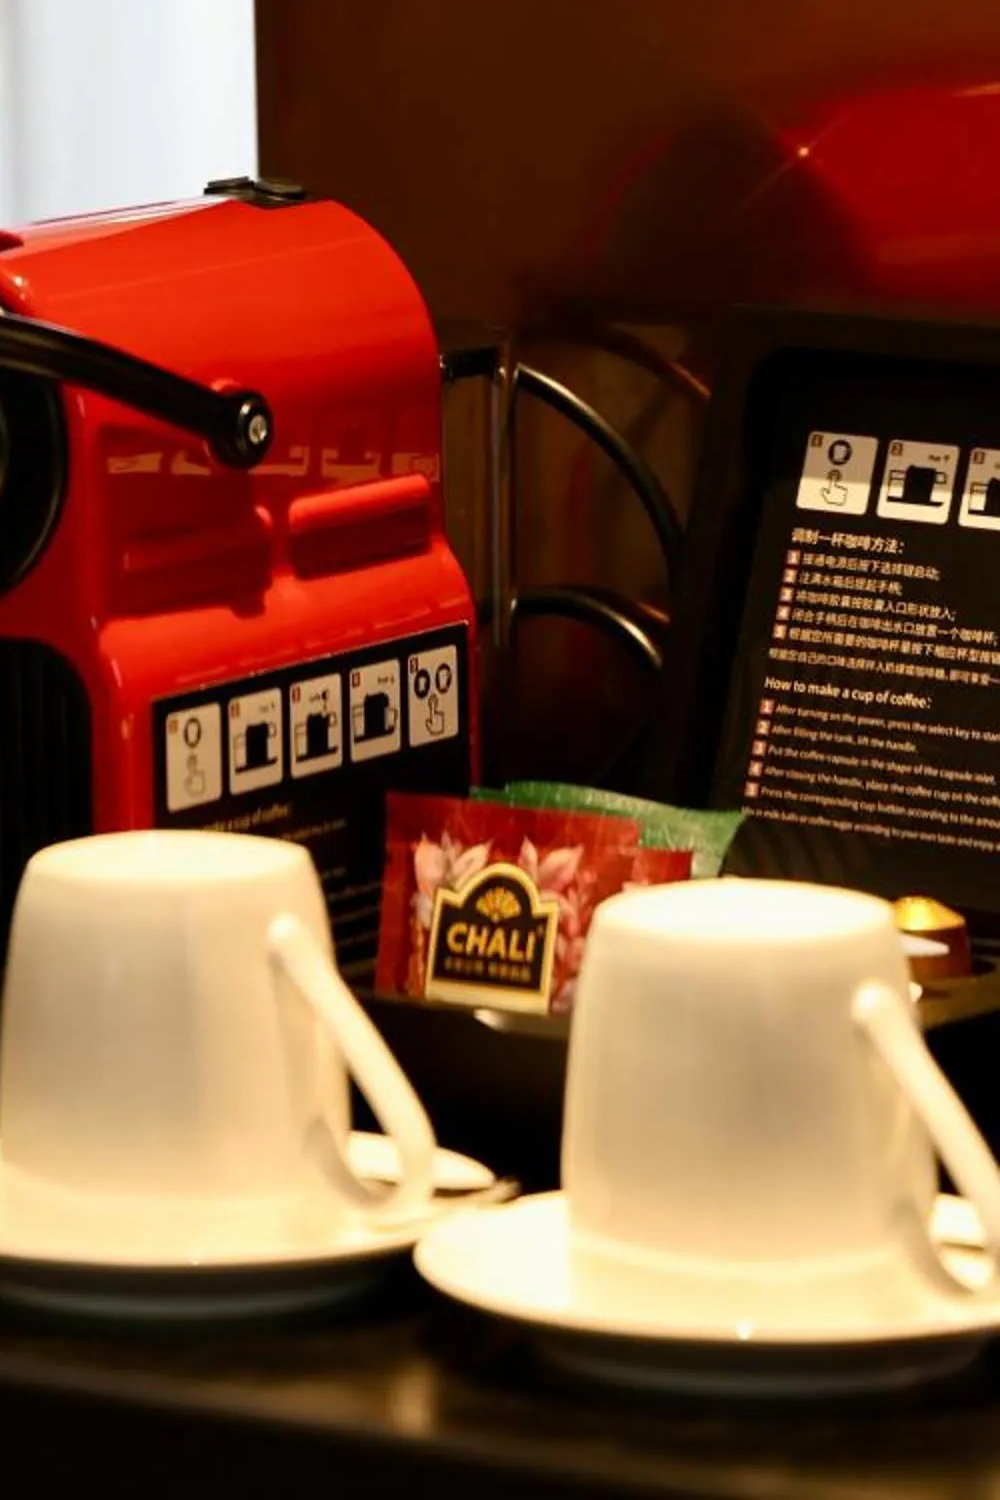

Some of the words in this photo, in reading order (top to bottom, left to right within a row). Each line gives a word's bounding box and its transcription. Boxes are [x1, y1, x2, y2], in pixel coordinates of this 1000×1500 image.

[764, 676, 791, 691] How
[793, 680, 806, 693] to
[807, 684, 840, 698] make
[841, 688, 850, 699] a
[851, 689, 875, 705] cup
[875, 689, 890, 704] of
[445, 921, 537, 964] CHALI
